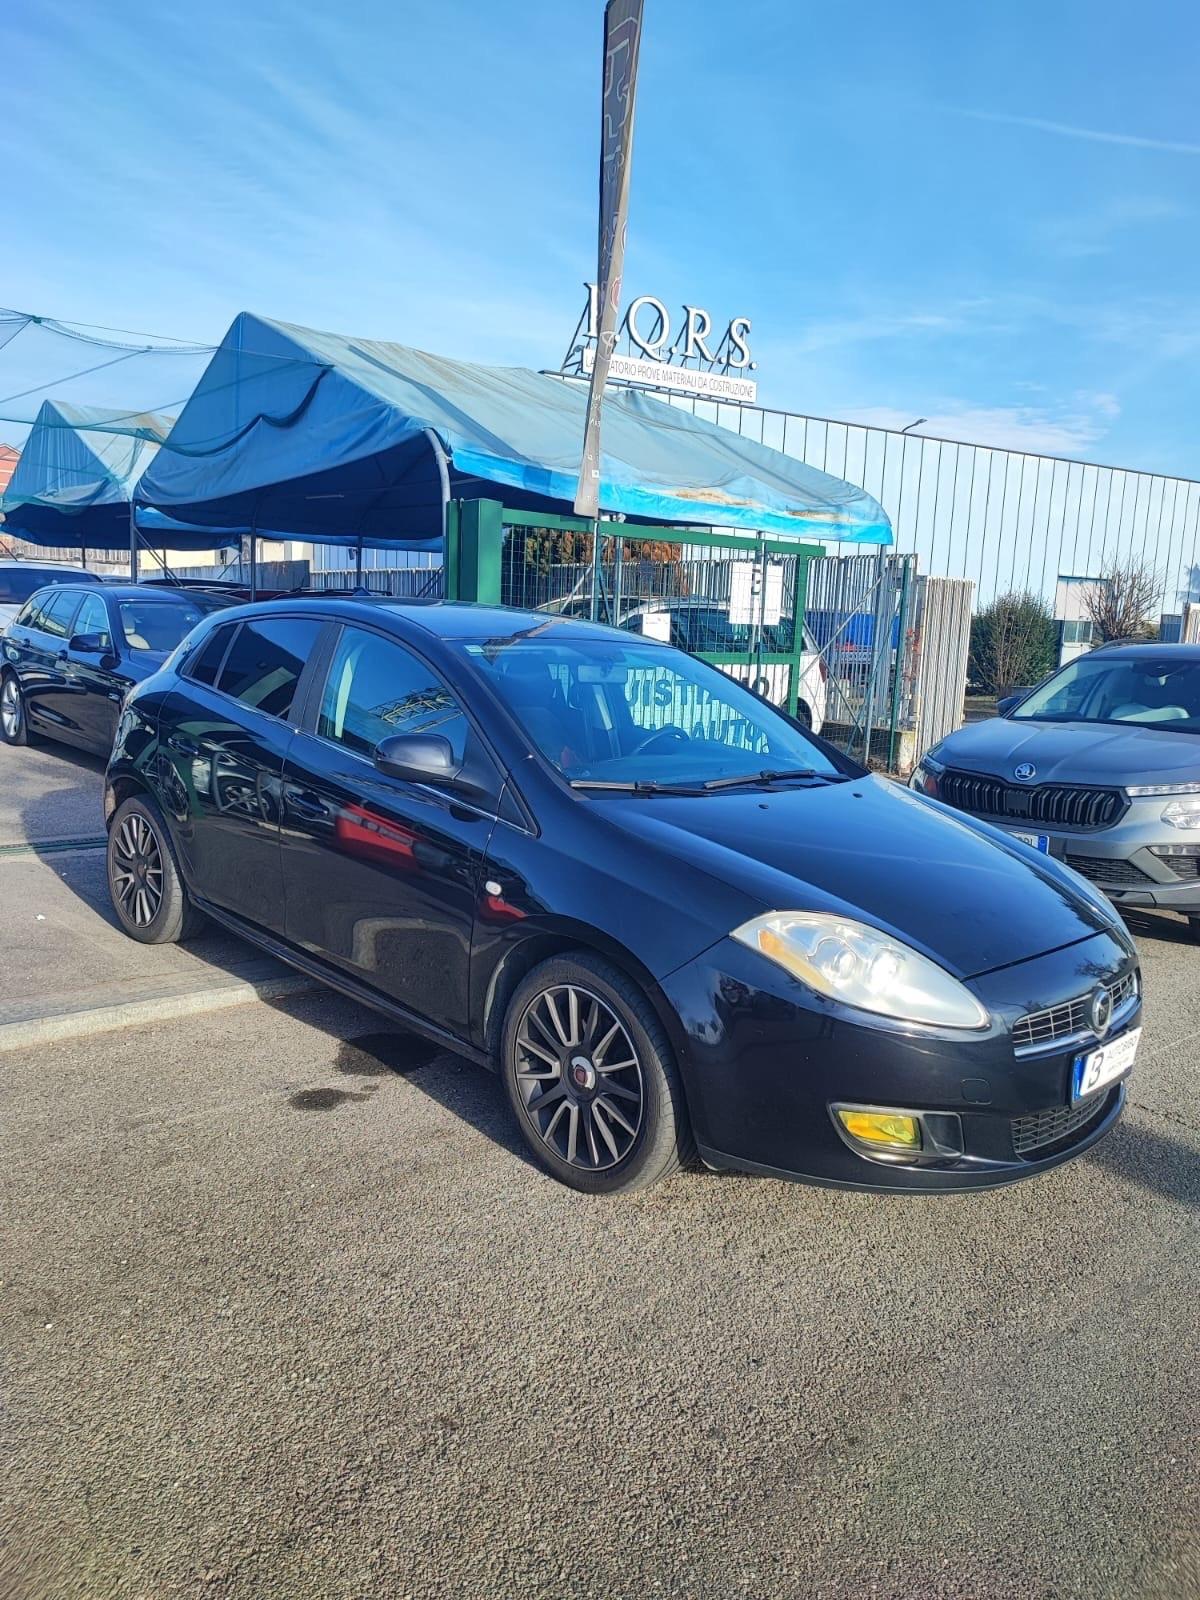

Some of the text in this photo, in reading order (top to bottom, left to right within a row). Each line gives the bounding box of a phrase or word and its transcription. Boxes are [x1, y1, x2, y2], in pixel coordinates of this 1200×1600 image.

[585, 356, 754, 398] LAATORIO PROVE MATERIALI DA COSTRUZIONE
